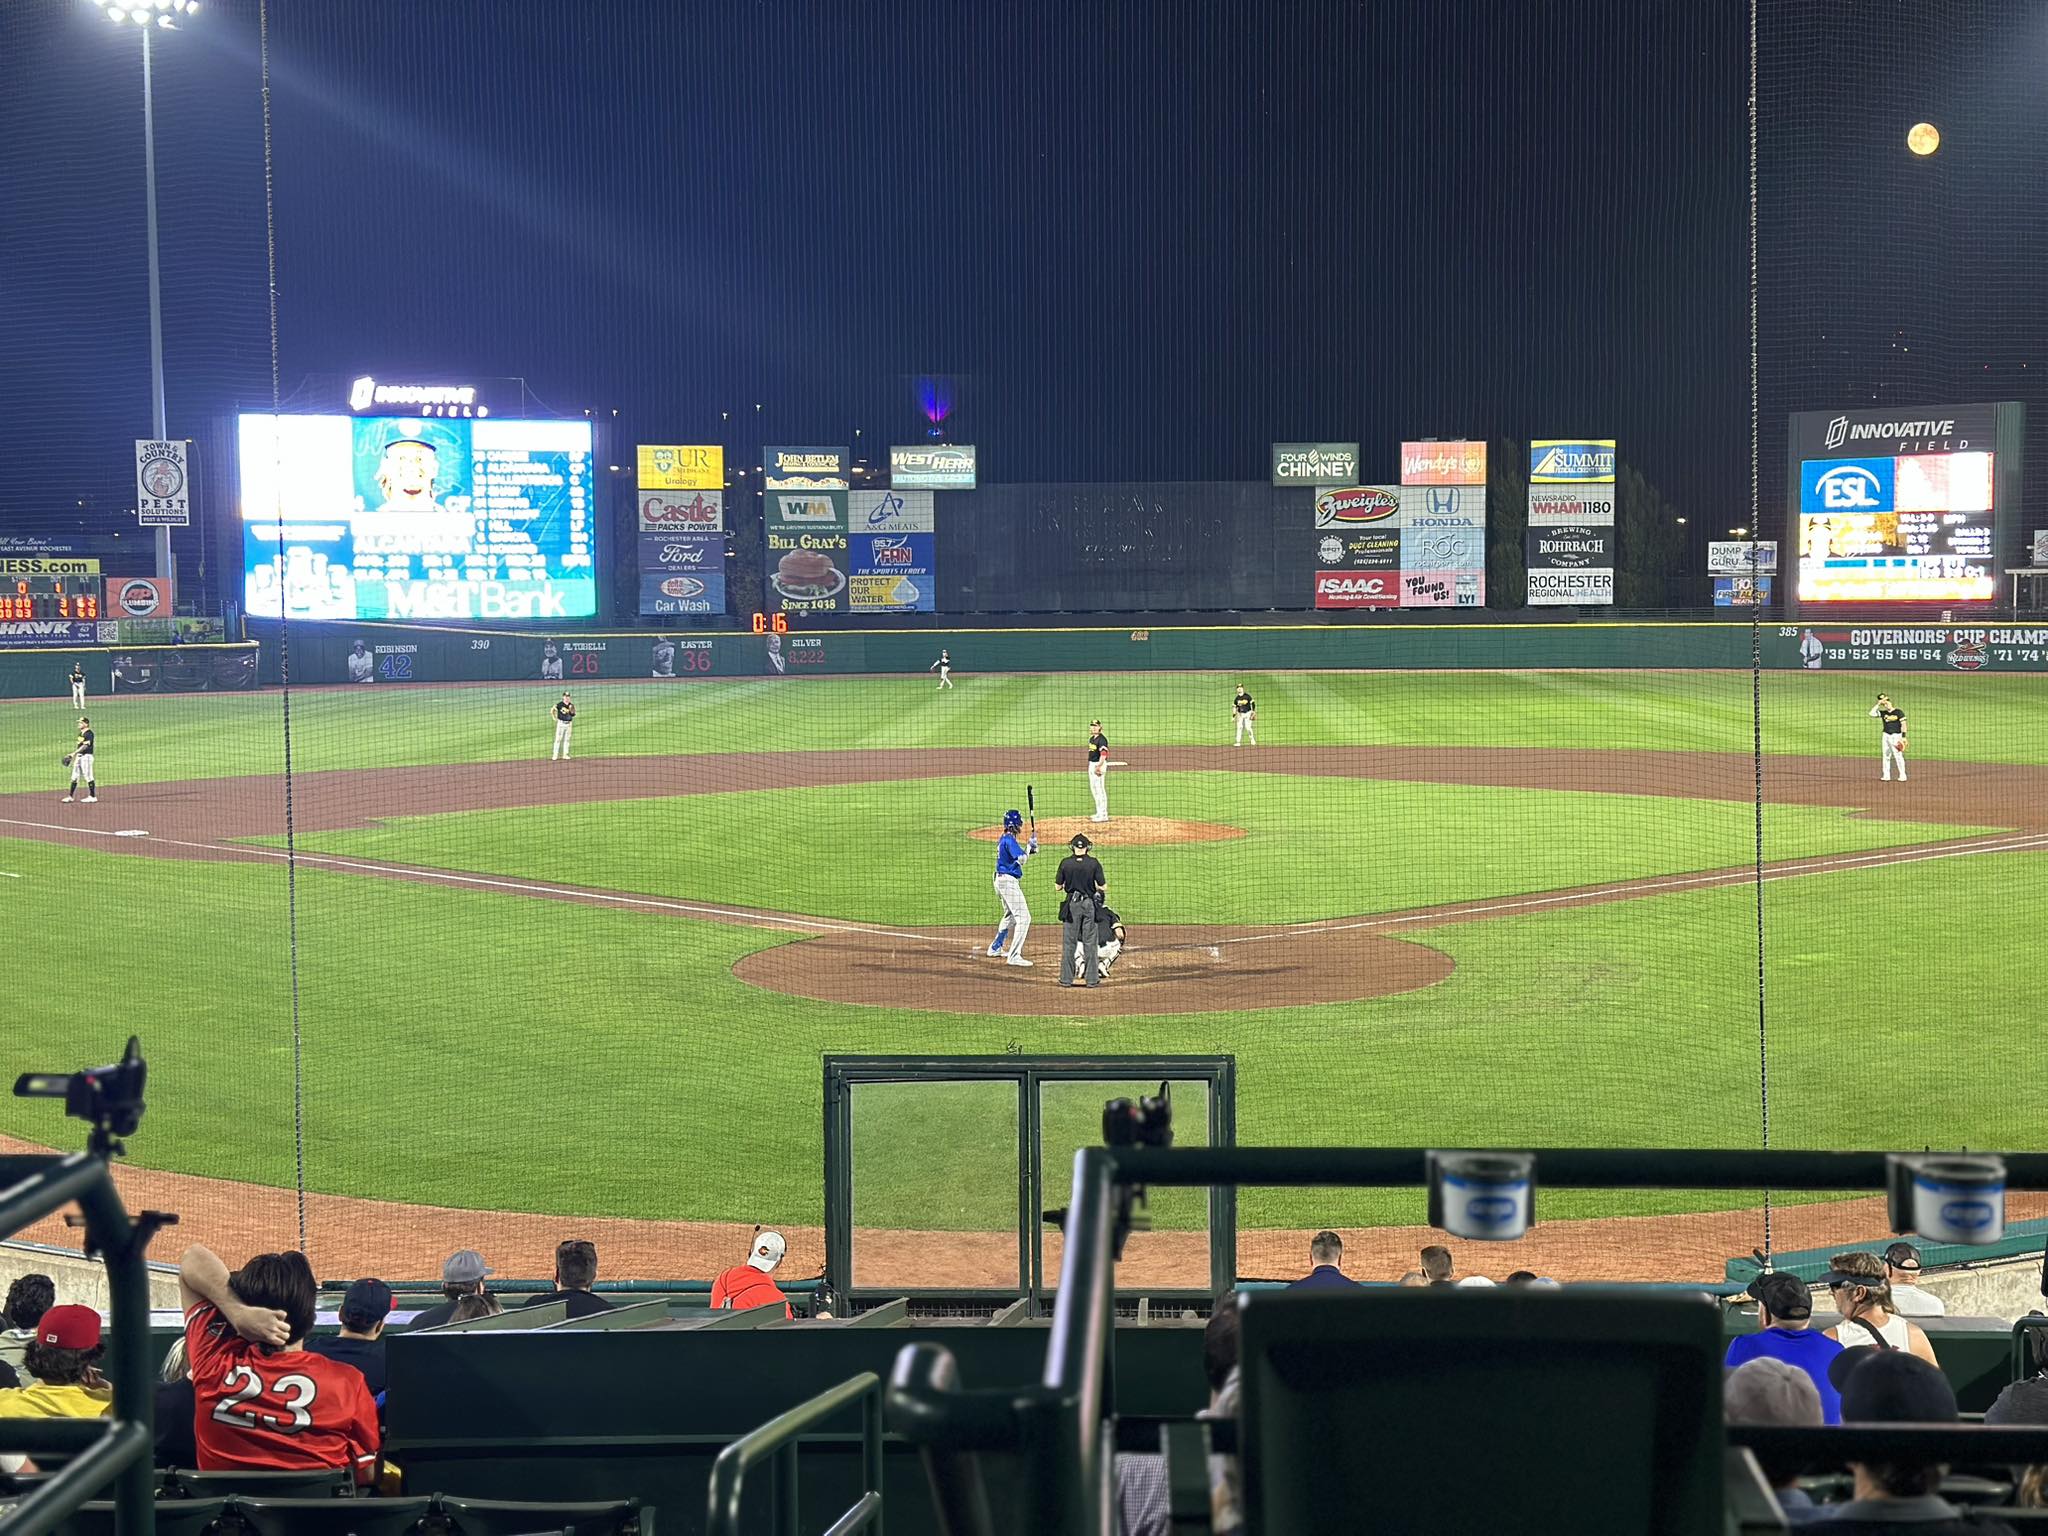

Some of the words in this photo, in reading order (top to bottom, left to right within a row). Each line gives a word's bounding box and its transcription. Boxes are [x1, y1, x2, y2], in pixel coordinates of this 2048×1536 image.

[423, 405, 488, 417] FIELD
[1850, 420, 1954, 440] INNOVATIVE
[143, 443, 170, 452] TOWN
[1900, 440, 1968, 452] FIELD
[140, 450, 184, 464] COUNTRY
[677, 449, 710, 467] UR
[775, 452, 803, 467] JOHN
[892, 453, 935, 464] WEST
[932, 457, 974, 469] HERR
[1281, 453, 1307, 462] FOUR
[1321, 453, 1352, 461] WINDS
[1555, 453, 1614, 467] SUMMIT
[1277, 462, 1355, 477] CHIMNEY
[1405, 452, 1457, 476] Wendy's
[665, 478, 697, 486] Urology
[1825, 477, 1880, 508] ESL
[141, 499, 185, 508] PEST
[643, 492, 717, 522] Castle
[787, 502, 827, 514] WM
[1317, 493, 1397, 527] Zweigle's
[1410, 518, 1473, 527] HONDA
[1551, 527, 1592, 536] BREWING
[768, 534, 797, 549] BILL
[800, 534, 847, 549] GRAY'S
[1349, 542, 1365, 550] DUCT
[1367, 540, 1399, 548] CLEANING
[1539, 539, 1604, 553] ROHRBACH
[659, 544, 704, 562] Ford
[880, 548, 912, 563] FAN
[1711, 547, 1741, 555] DUMP
[1551, 558, 1590, 568] COMPANY
[1711, 558, 1739, 566] GURU
[1318, 579, 1384, 593] ISAAC
[1405, 576, 1425, 588] YOU
[1529, 575, 1612, 588] ROCHESTER
[1412, 582, 1445, 596] FOUND
[1529, 589, 1575, 597] REGIONAL
[1577, 589, 1612, 597] HEALTH
[385, 581, 479, 617] M&T
[481, 581, 565, 617] Bank
[1434, 591, 1449, 601] US!
[656, 600, 675, 611] Car
[678, 600, 710, 611] Wash
[781, 599, 809, 609] SINCE
[811, 599, 836, 609] 1938
[753, 613, 787, 632] 0:16
[1779, 627, 1798, 636] 385
[1851, 629, 1950, 645] GOVERNORS'
[1953, 629, 1986, 645] CUP
[471, 639, 490, 650] 390
[681, 641, 712, 649] EASTER
[792, 639, 821, 647] SILVER
[375, 645, 418, 654] ROBINSON
[1825, 649, 1846, 660] '39
[1849, 649, 1870, 660] '52
[1872, 649, 1893, 660] '55
[1896, 649, 1917, 660] '56
[1919, 649, 1942, 660] '64
[1994, 650, 2013, 661] '71
[2017, 650, 2039, 661] '74
[379, 655, 412, 678] 42
[572, 653, 599, 673] 26
[683, 651, 711, 671] 36
[211, 1365, 317, 1434] 23
